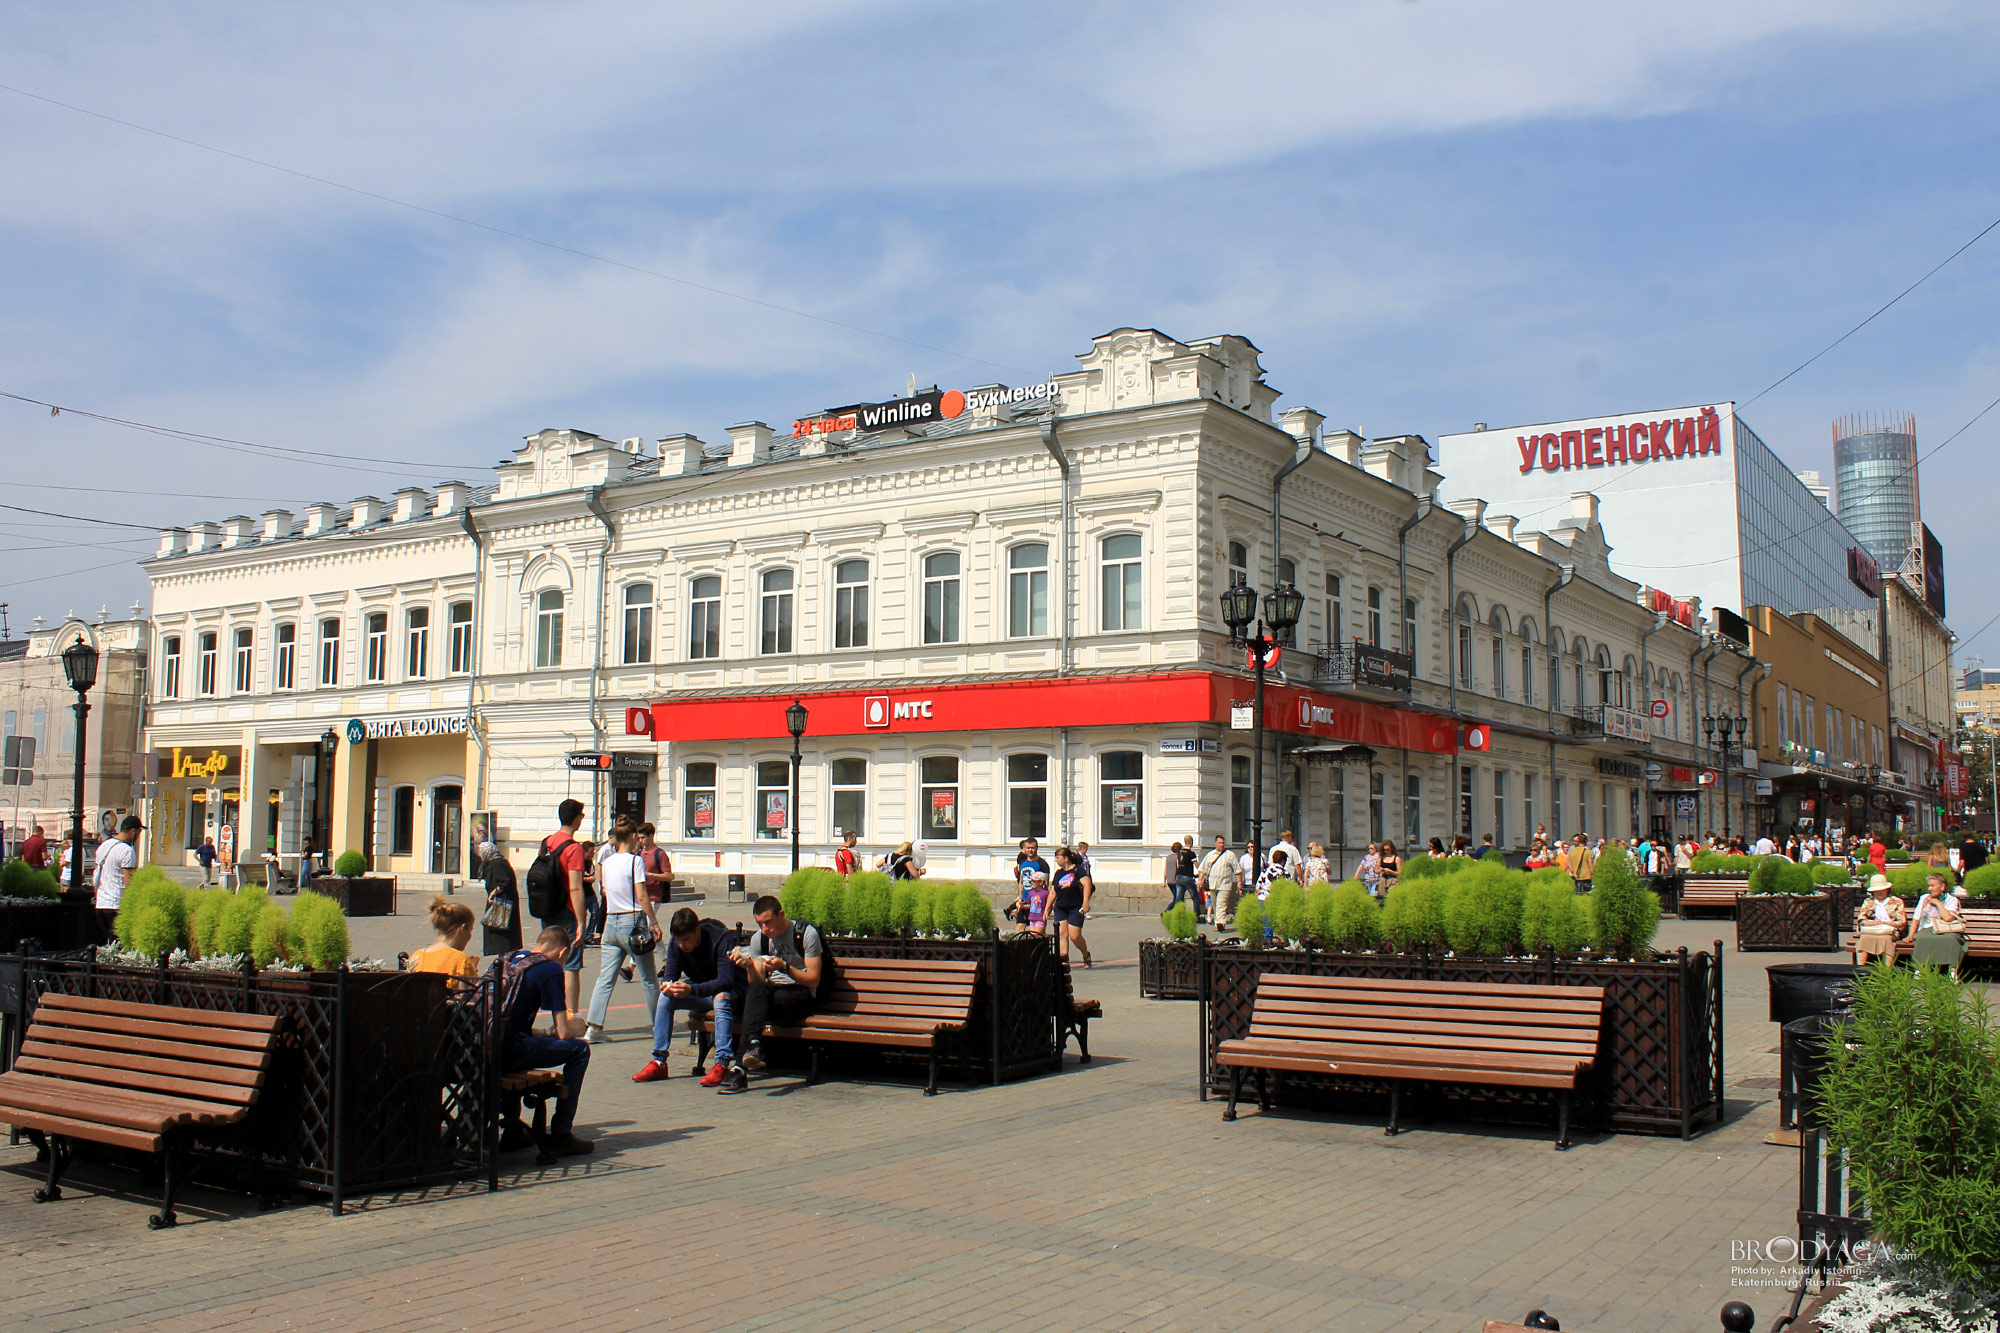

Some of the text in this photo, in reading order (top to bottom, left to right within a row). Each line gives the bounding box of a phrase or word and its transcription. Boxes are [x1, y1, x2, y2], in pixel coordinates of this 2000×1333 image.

[966, 381, 1060, 412] Букмекер
[863, 401, 932, 427] Winline
[791, 415, 855, 438] 24 часа
[1517, 406, 1721, 472] УСПЕНСКИЙ
[894, 700, 933, 719] МТС
[366, 717, 468, 738] МЯТА LOUNGE
[1187, 741, 1194, 750] 2
[570, 757, 596, 766] Winline
[624, 757, 653, 767] Букмекер
